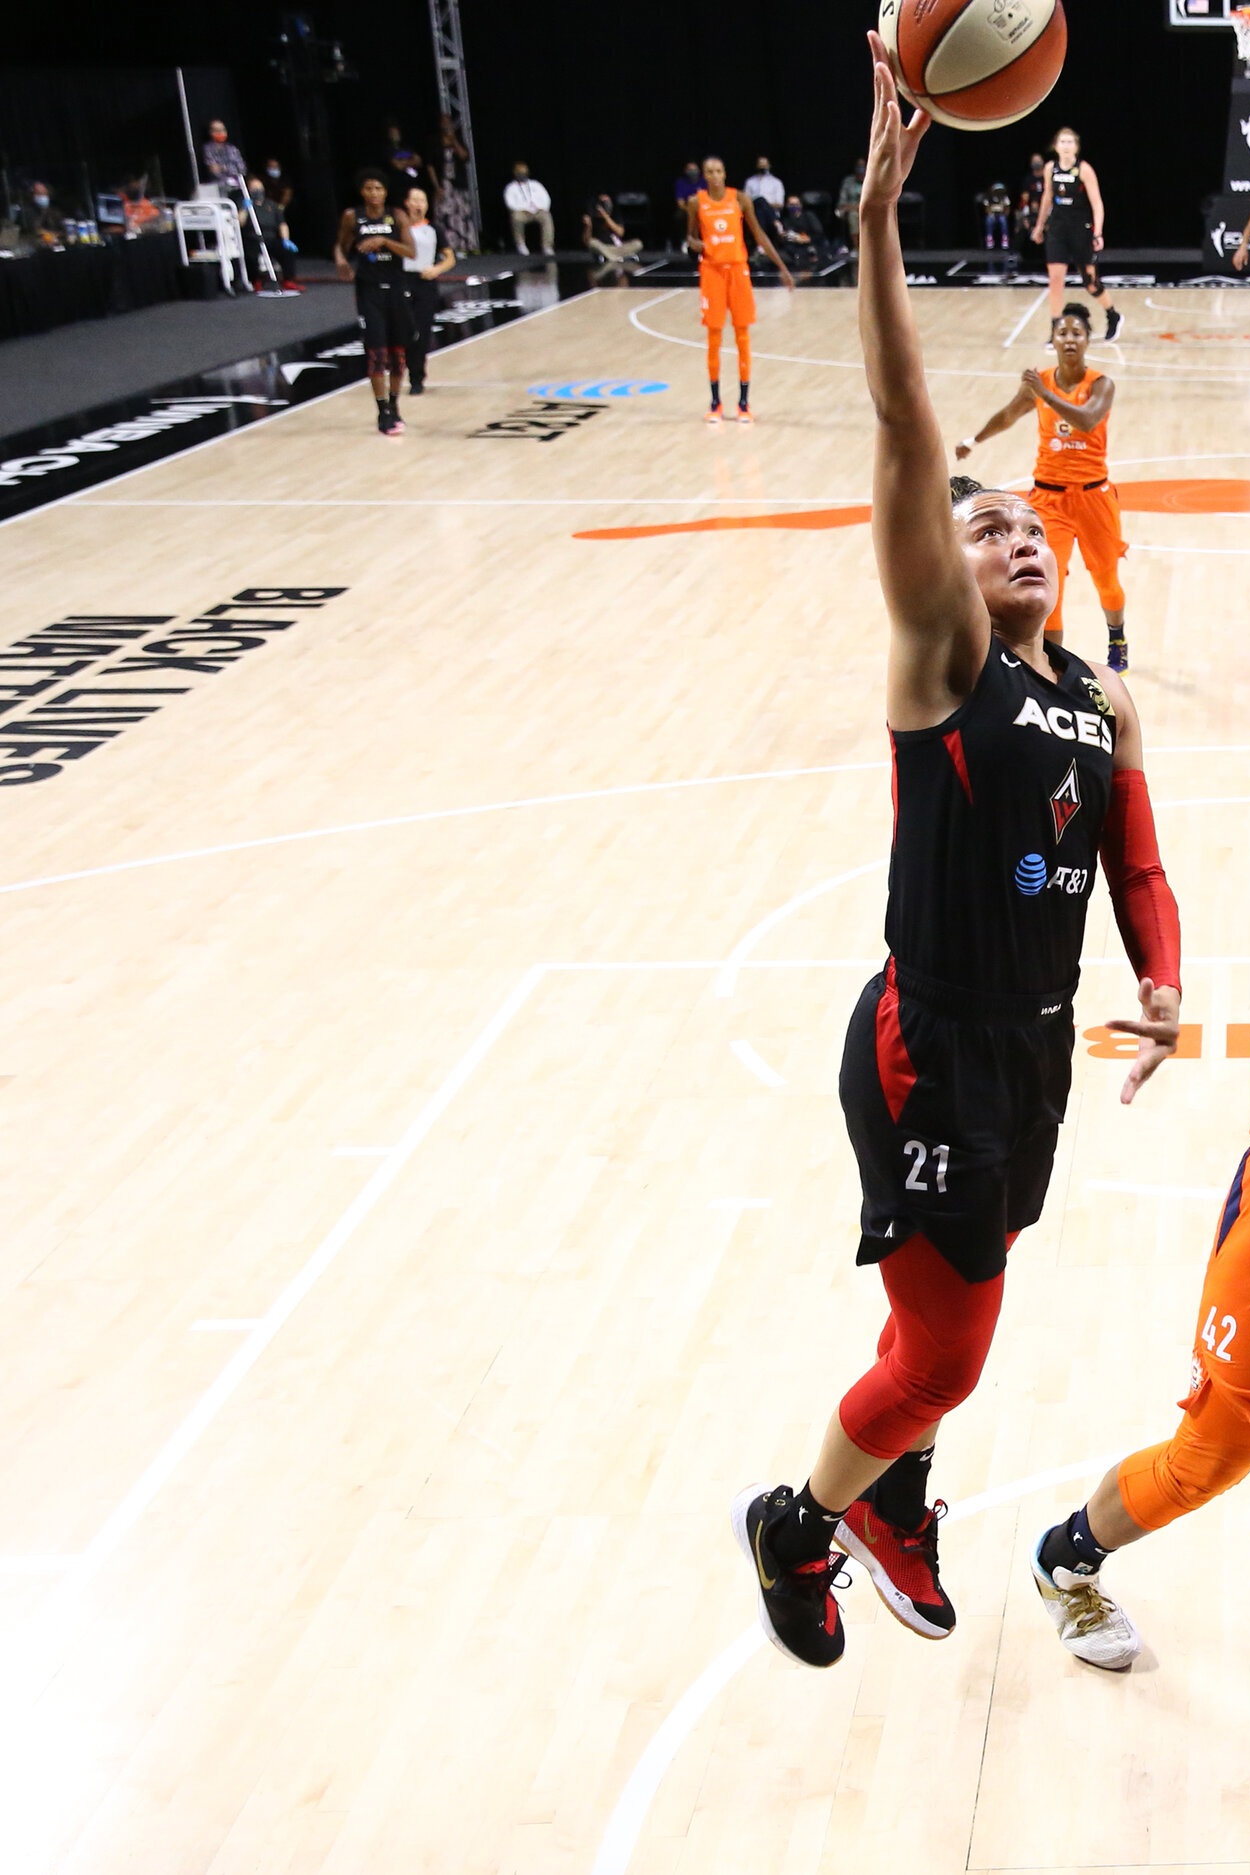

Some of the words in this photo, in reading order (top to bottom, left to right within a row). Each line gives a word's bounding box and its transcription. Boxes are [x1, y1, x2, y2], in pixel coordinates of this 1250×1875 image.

[97, 588, 350, 676] BLACK
[0, 616, 179, 716] MATT
[1013, 696, 1113, 755] ACES
[903, 1139, 950, 1193] 21
[1201, 1306, 1237, 1361] 42
